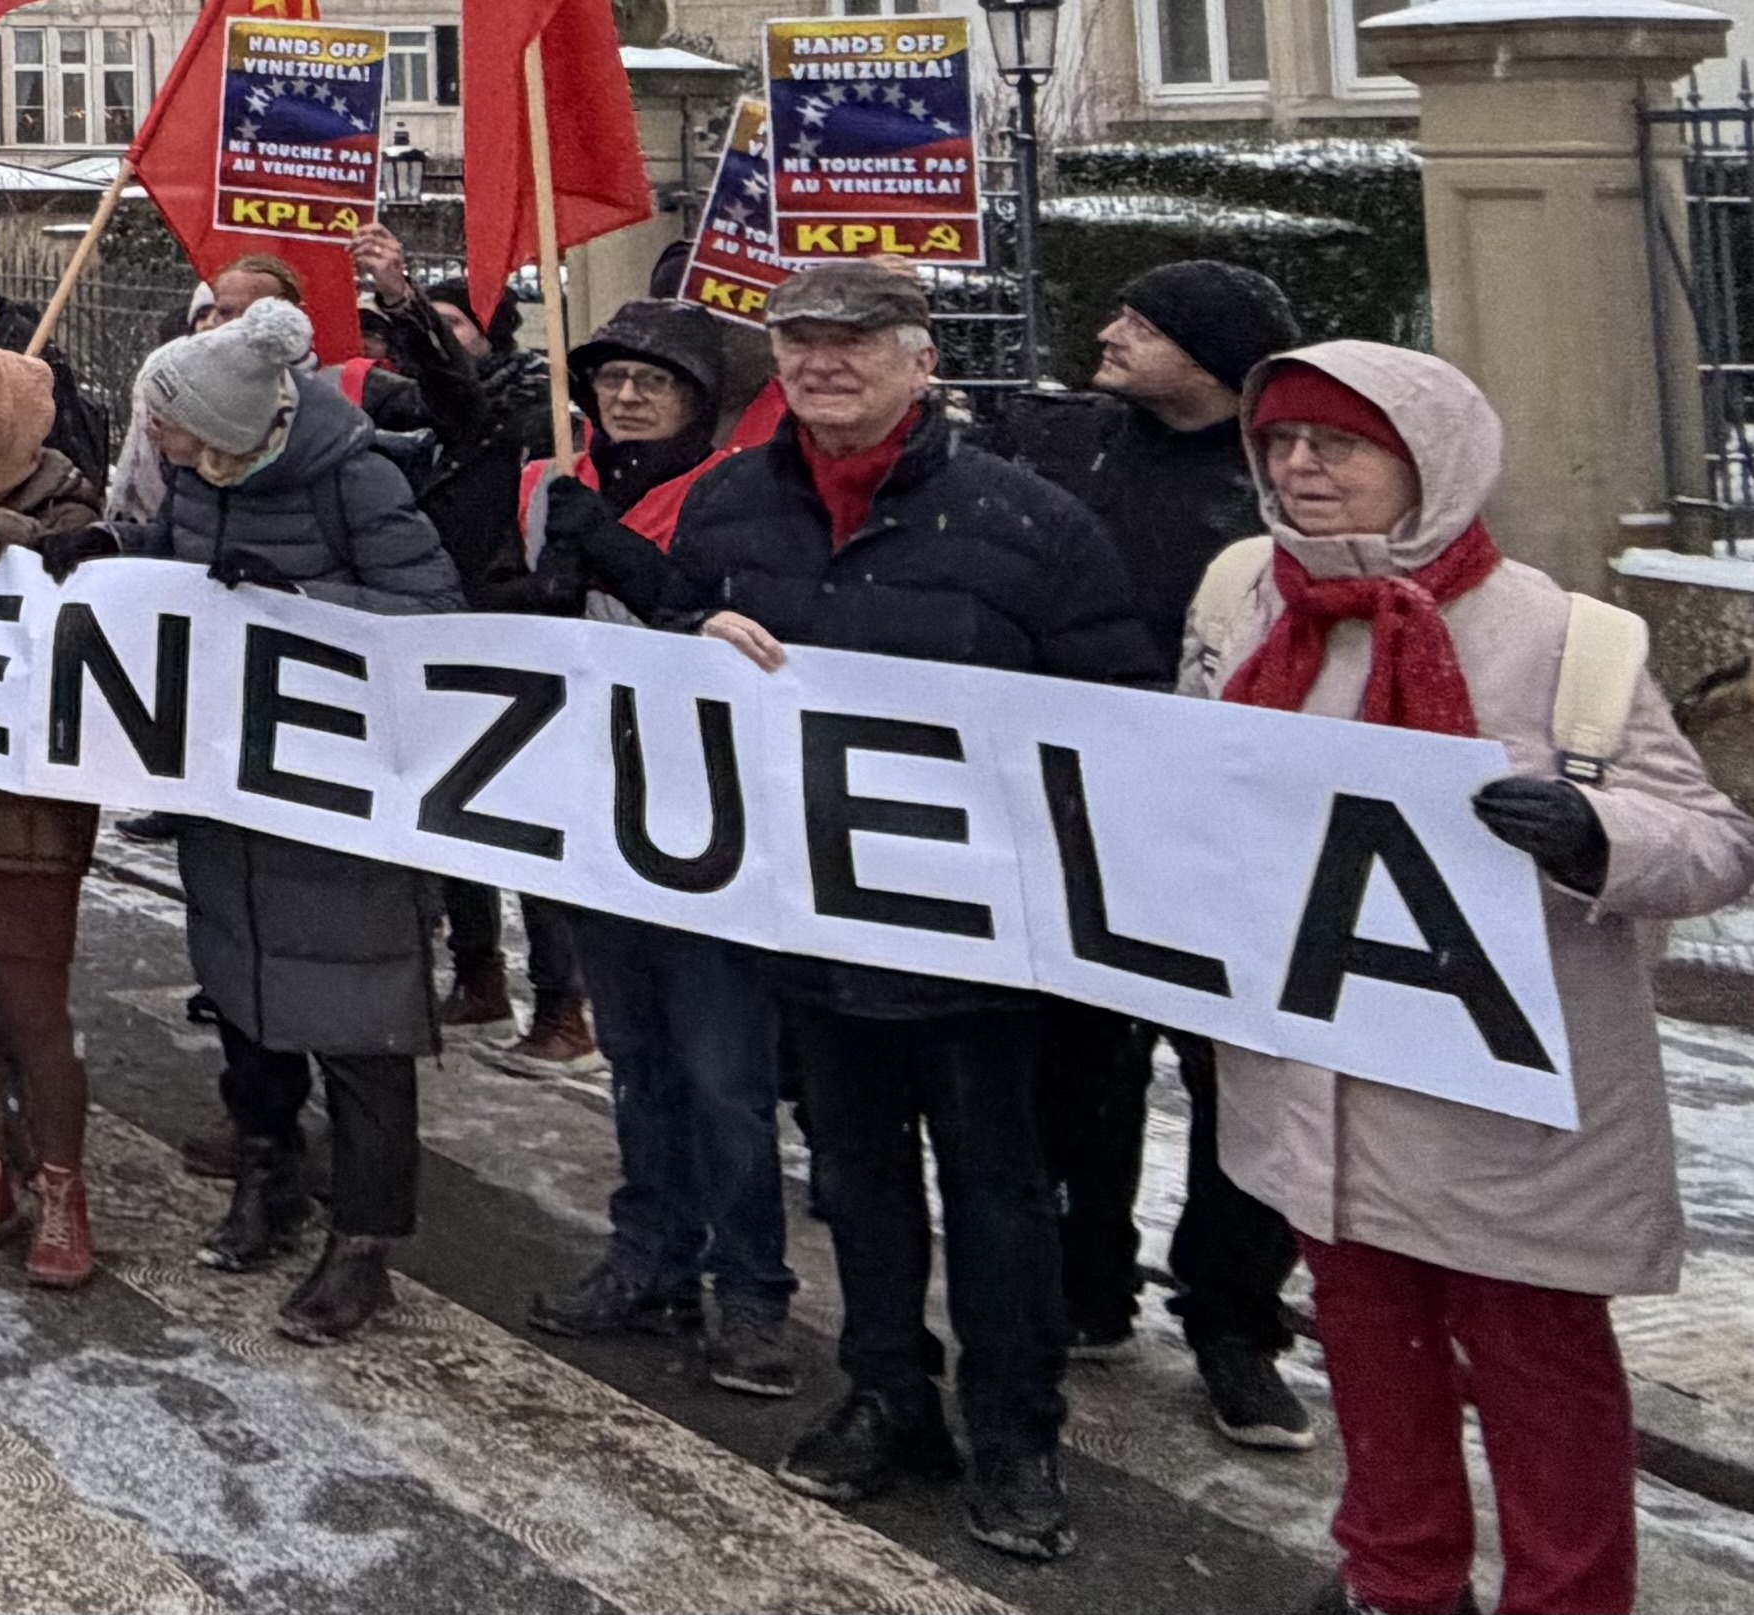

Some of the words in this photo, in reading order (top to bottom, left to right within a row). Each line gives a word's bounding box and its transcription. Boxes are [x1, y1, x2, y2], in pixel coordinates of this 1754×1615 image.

[248, 35, 322, 56] HANDS
[328, 41, 369, 58] OFF
[792, 35, 885, 55] HANDS
[895, 34, 946, 53] OFF
[242, 56, 371, 83] VENEZUELA!
[788, 58, 954, 81] VENEZUELA!
[228, 139, 252, 154] NE
[256, 141, 334, 162] TOUCHEZ
[339, 148, 373, 165] PAS
[782, 157, 812, 173] NE
[817, 157, 918, 173] TOUCHEZ
[924, 157, 968, 173] PAS
[232, 157, 256, 172] AU
[261, 160, 366, 183] VENEZUELA!
[791, 178, 821, 194] AU
[826, 177, 962, 194] VENEZUELA!
[232, 197, 325, 231] KPL
[796, 223, 916, 254] KPL
[699, 276, 768, 314] KP
